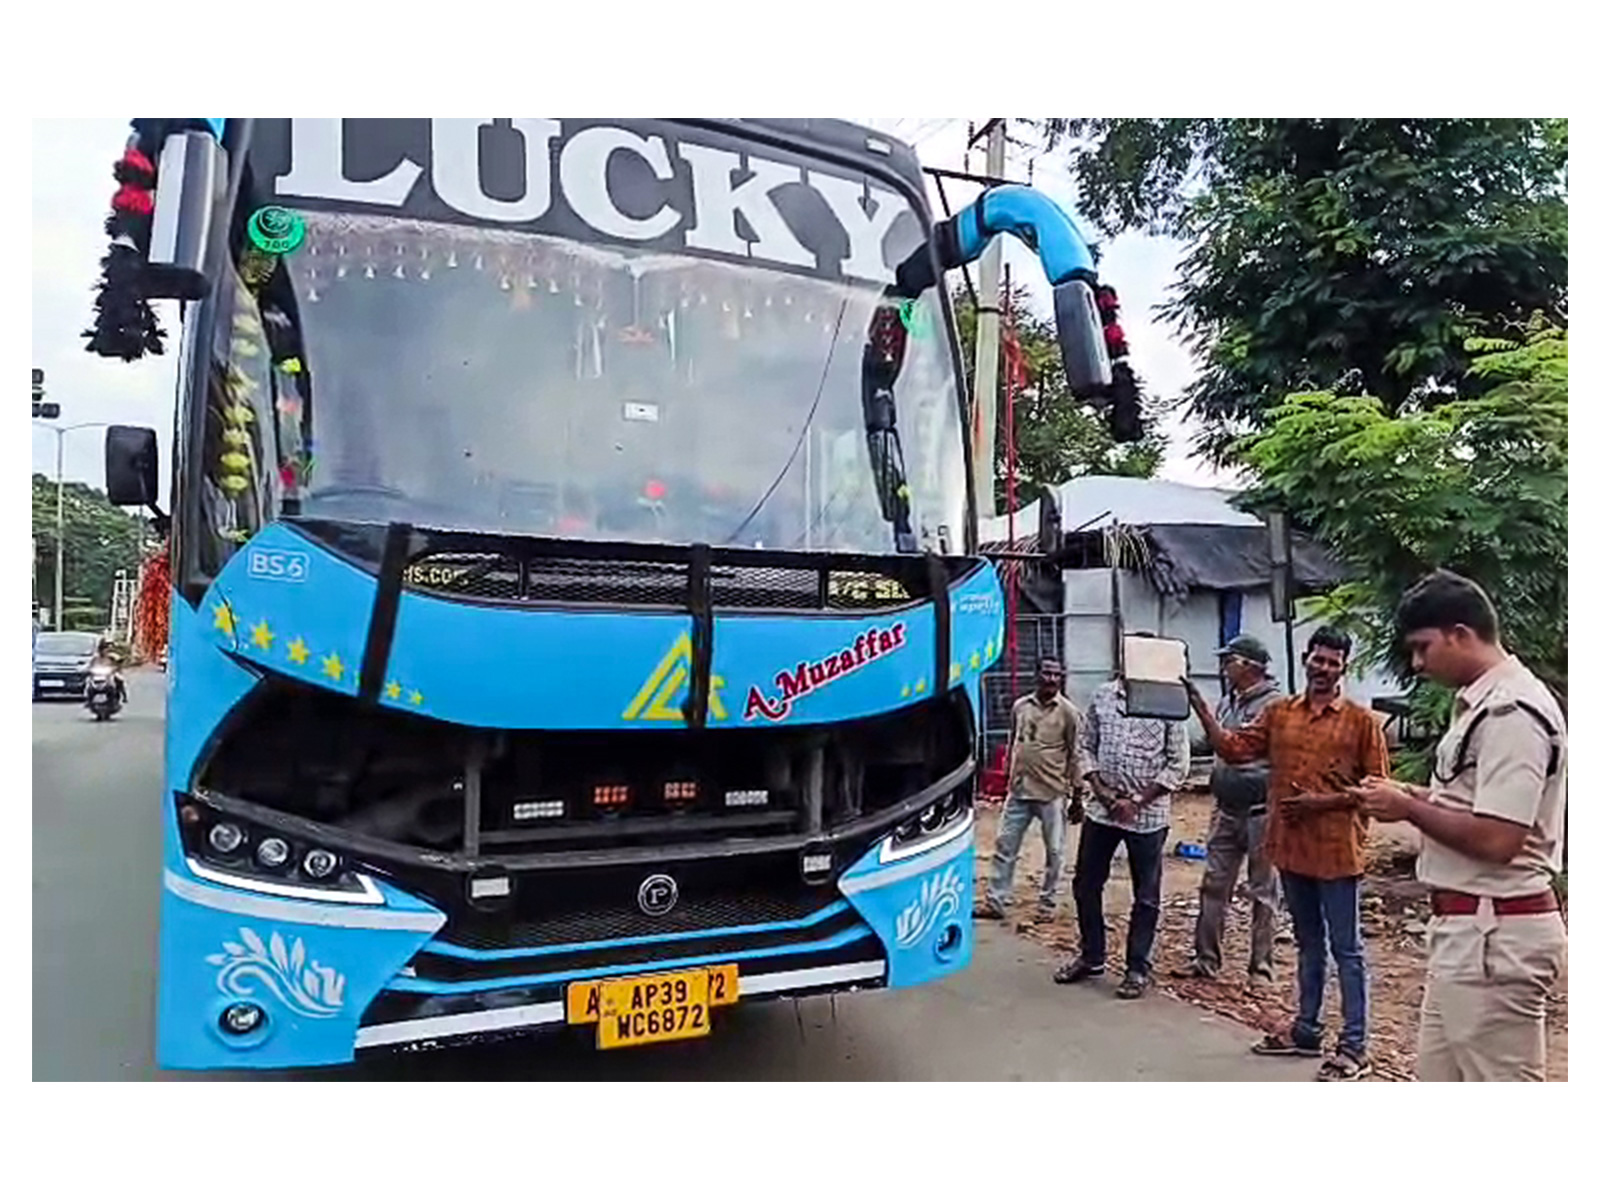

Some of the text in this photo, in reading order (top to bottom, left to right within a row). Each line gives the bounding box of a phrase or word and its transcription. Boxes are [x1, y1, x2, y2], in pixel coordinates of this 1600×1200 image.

[275, 118, 908, 285] LUCKY
[774, 620, 906, 702] Muzaffar
[631, 980, 687, 1009] AP39
